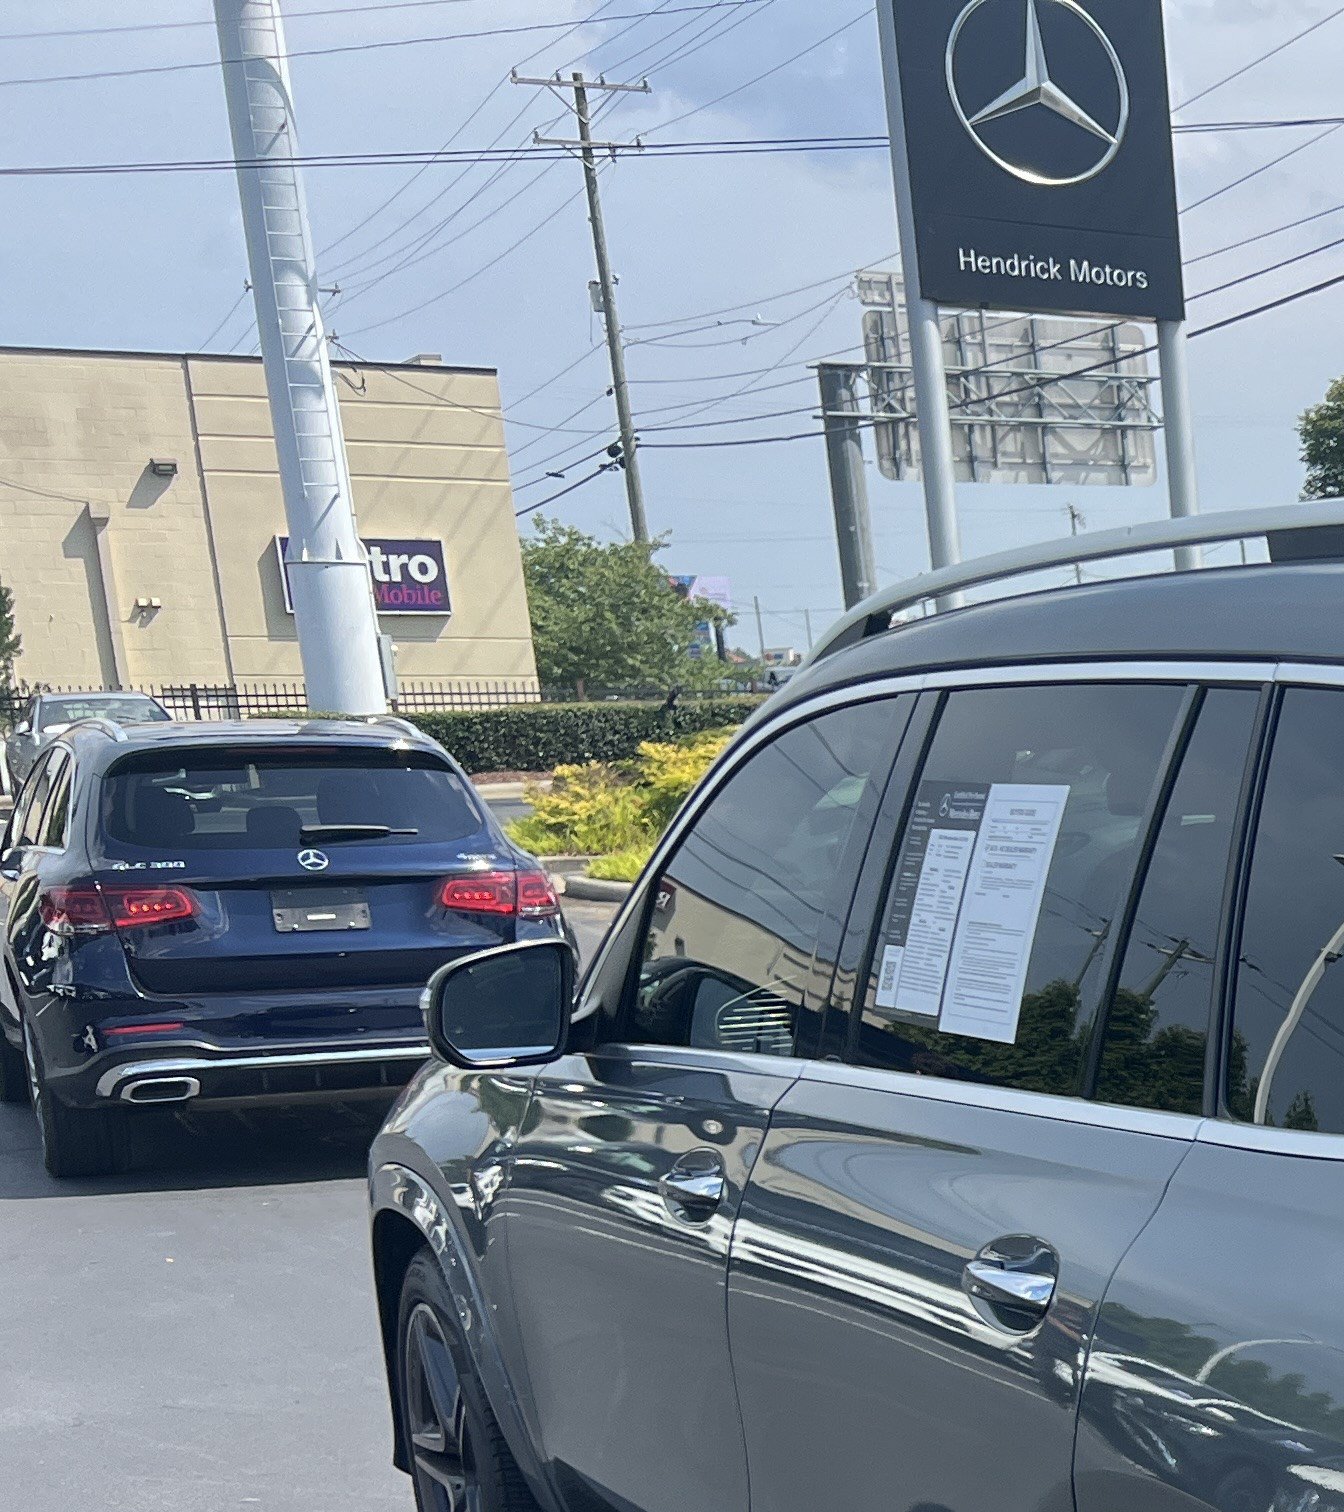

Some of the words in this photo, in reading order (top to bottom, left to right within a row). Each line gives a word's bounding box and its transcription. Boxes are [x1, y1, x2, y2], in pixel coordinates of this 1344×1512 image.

[958, 247, 1063, 281] Hendrick
[1069, 258, 1149, 289] Motors
[368, 546, 439, 583] tro
